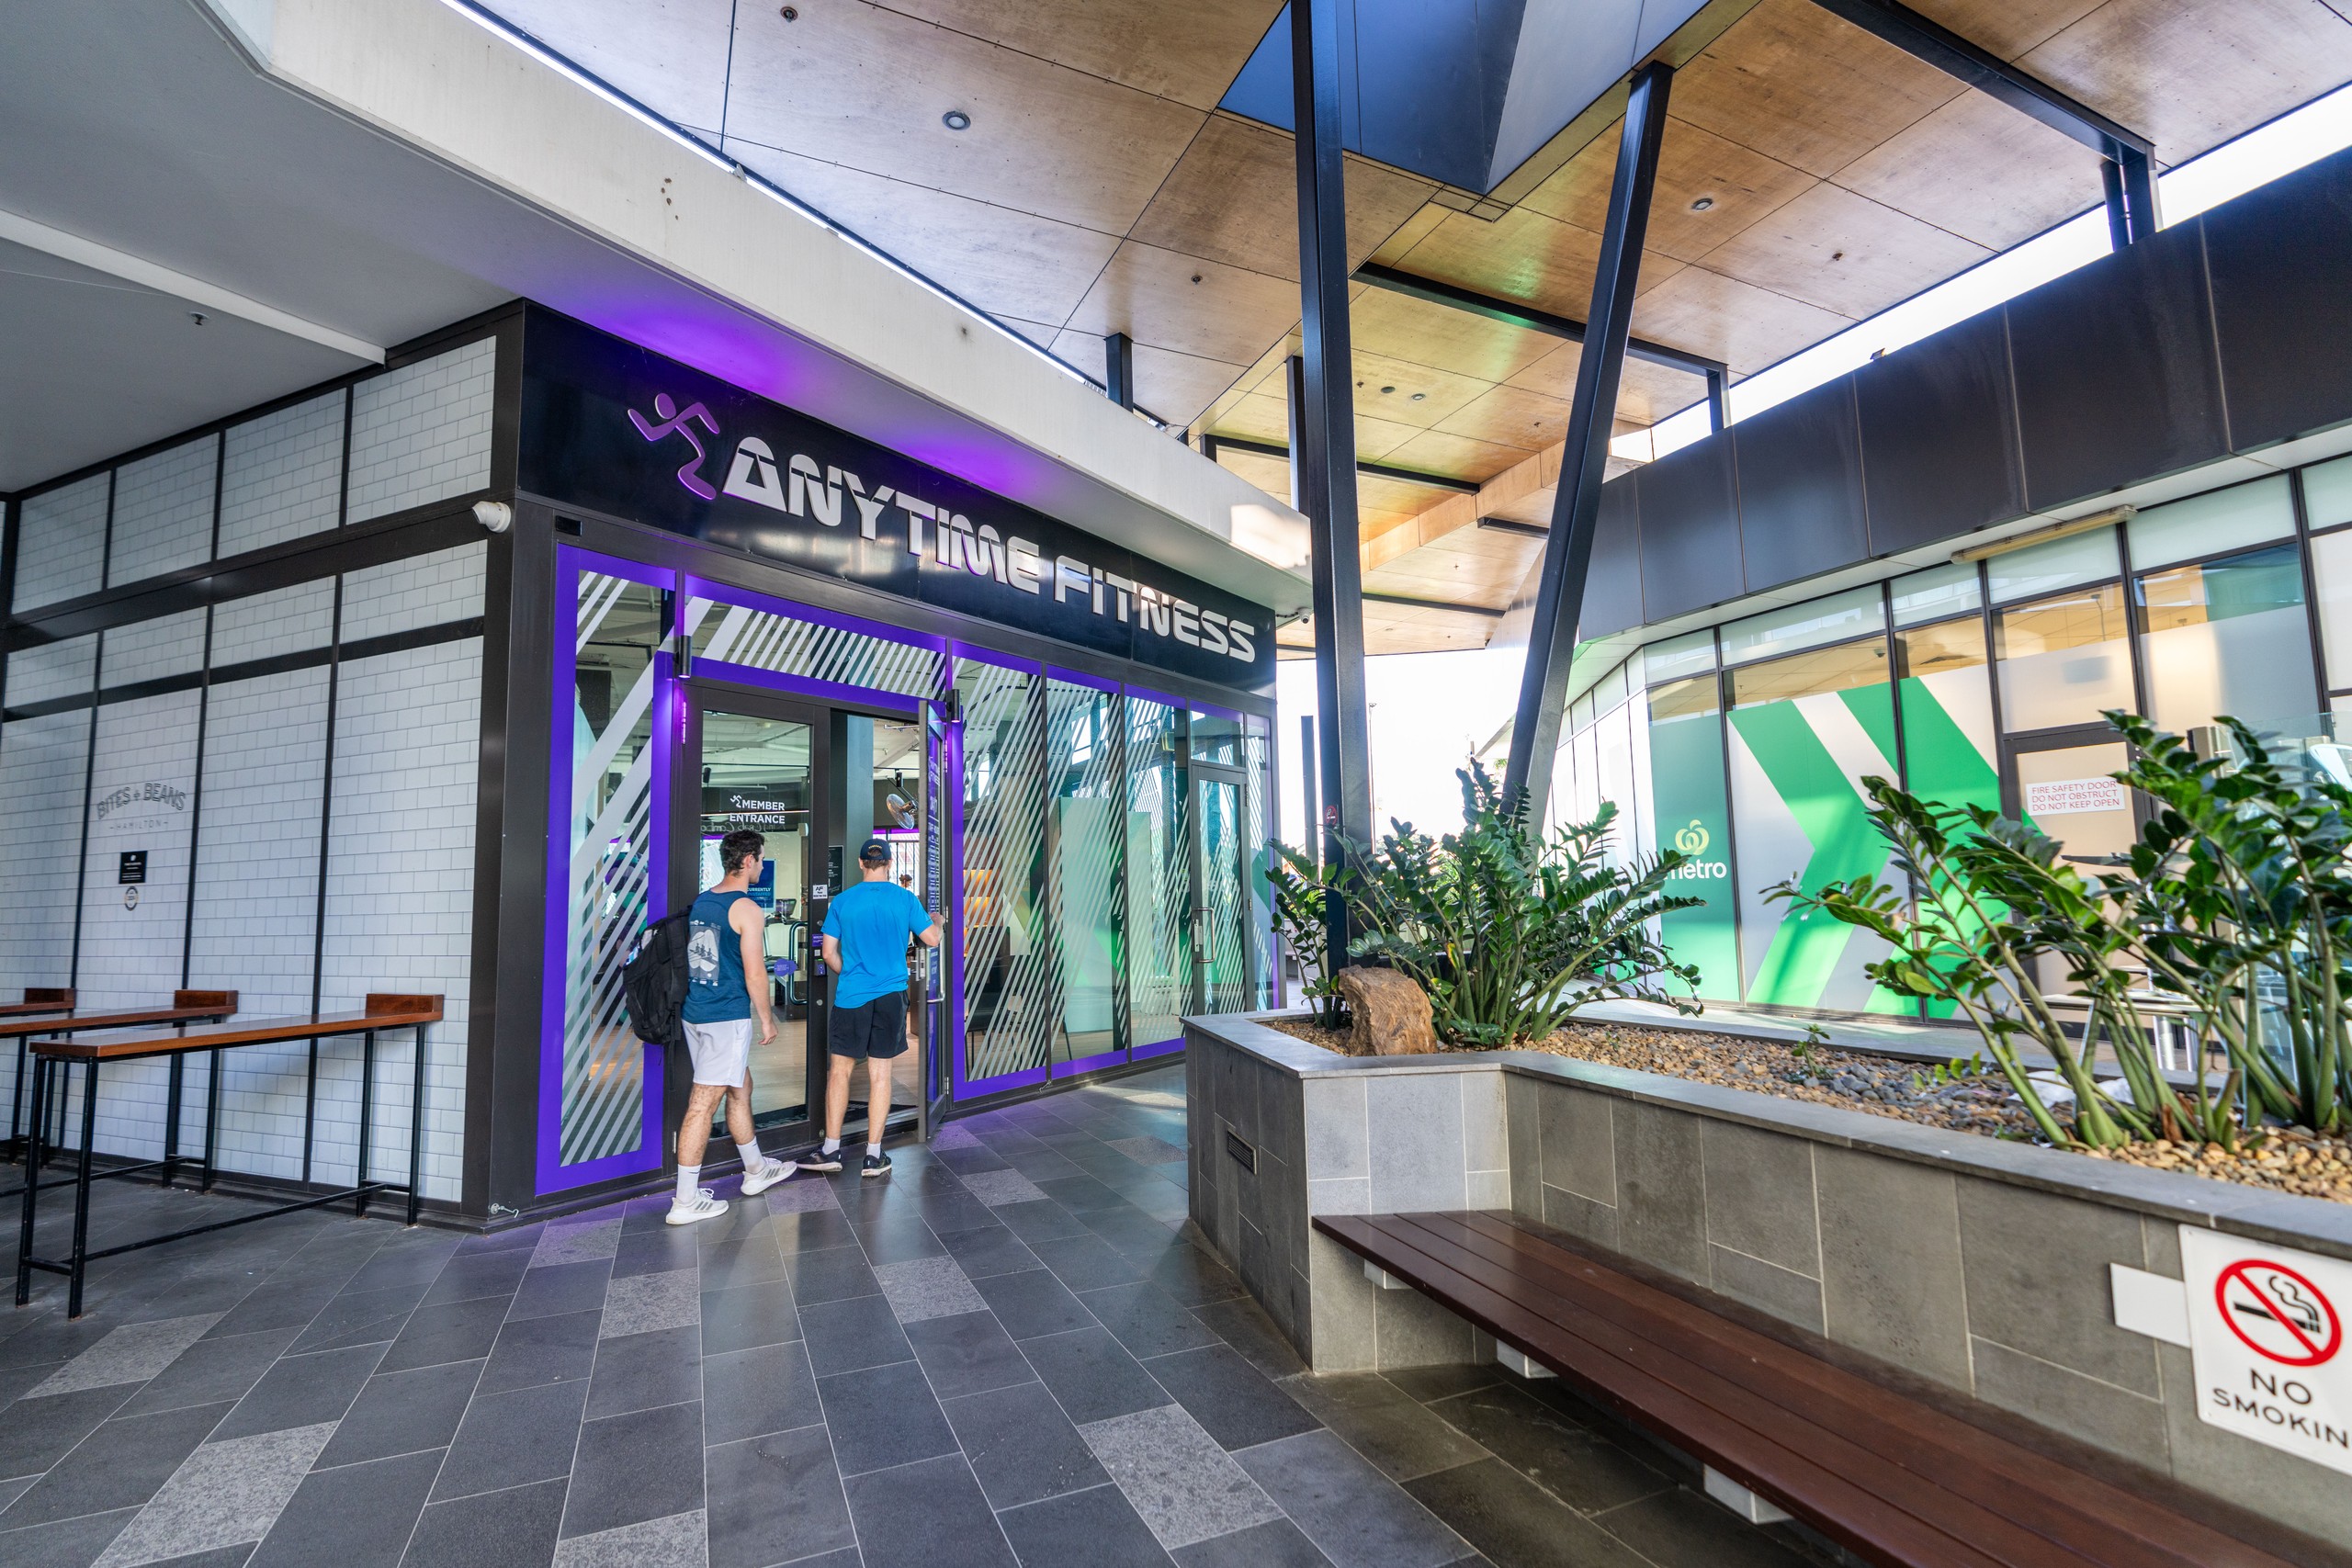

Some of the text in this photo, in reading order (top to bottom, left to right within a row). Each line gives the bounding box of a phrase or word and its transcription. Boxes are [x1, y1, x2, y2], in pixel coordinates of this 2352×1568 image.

[721, 436, 1256, 663] ANYTIME FITNESS
[2052, 784, 2085, 793] SAFETY
[2087, 781, 2117, 790] DOOR
[96, 786, 130, 819] BITES
[143, 783, 186, 811] BEANS
[2048, 794, 2066, 802] NOT
[2068, 790, 2118, 800] OBSTRUCT
[741, 799, 786, 811] MEMBER
[2032, 804, 2046, 812] DO
[2048, 802, 2067, 810] NOT
[2069, 800, 2091, 809] KEEP
[729, 813, 786, 824] ENTRANCE
[2250, 1368, 2312, 1405] NO
